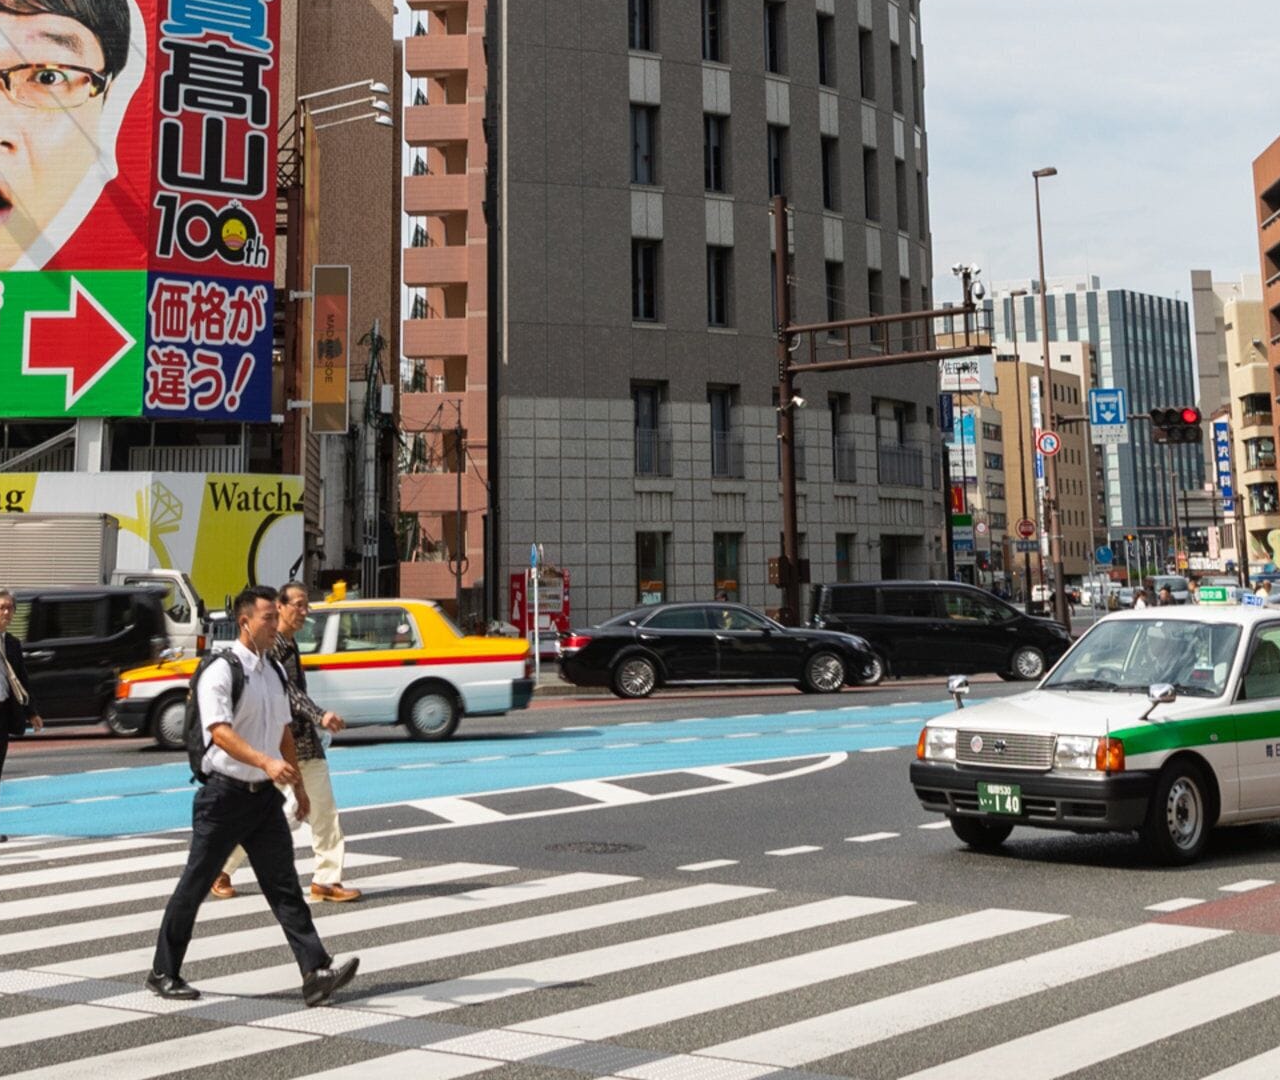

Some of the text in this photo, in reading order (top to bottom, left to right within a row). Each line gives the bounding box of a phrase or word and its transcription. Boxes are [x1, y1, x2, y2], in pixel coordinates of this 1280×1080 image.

[154, 192, 268, 267] 100th
[151, 279, 268, 346] 価格が
[148, 346, 255, 412] 違う!
[209, 482, 293, 512] Watch
